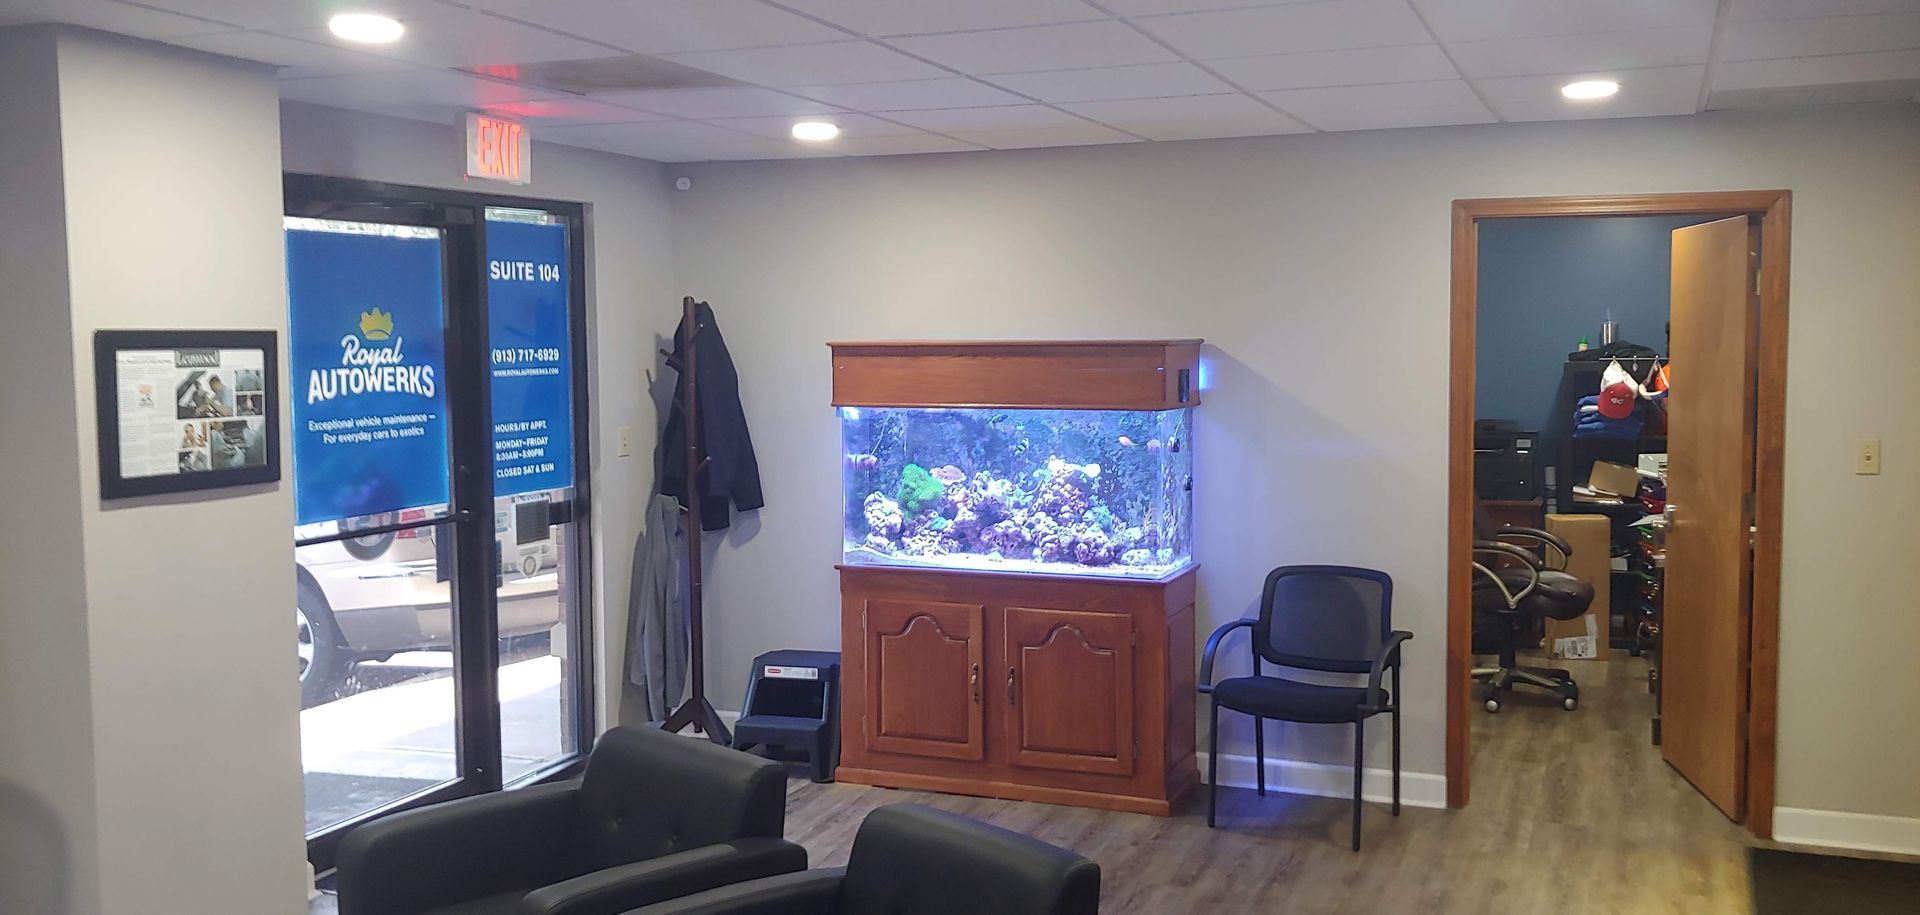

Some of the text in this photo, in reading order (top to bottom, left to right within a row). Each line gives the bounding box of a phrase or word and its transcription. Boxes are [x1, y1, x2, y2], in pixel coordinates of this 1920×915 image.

[479, 117, 522, 177] EXIT
[490, 260, 560, 282] SUITE 104
[341, 334, 404, 377] Royal
[493, 347, 559, 364] (913) 717-6929
[307, 364, 435, 405] AUTOWERKS
[308, 418, 354, 432] Exceptional
[355, 416, 381, 428] vehicle
[382, 413, 428, 426] maintenance
[323, 425, 425, 445] For everyday cars to exotics
[496, 466, 523, 479] CLOSED
[522, 465, 535, 476] SAT
[540, 463, 555, 473] SUN
